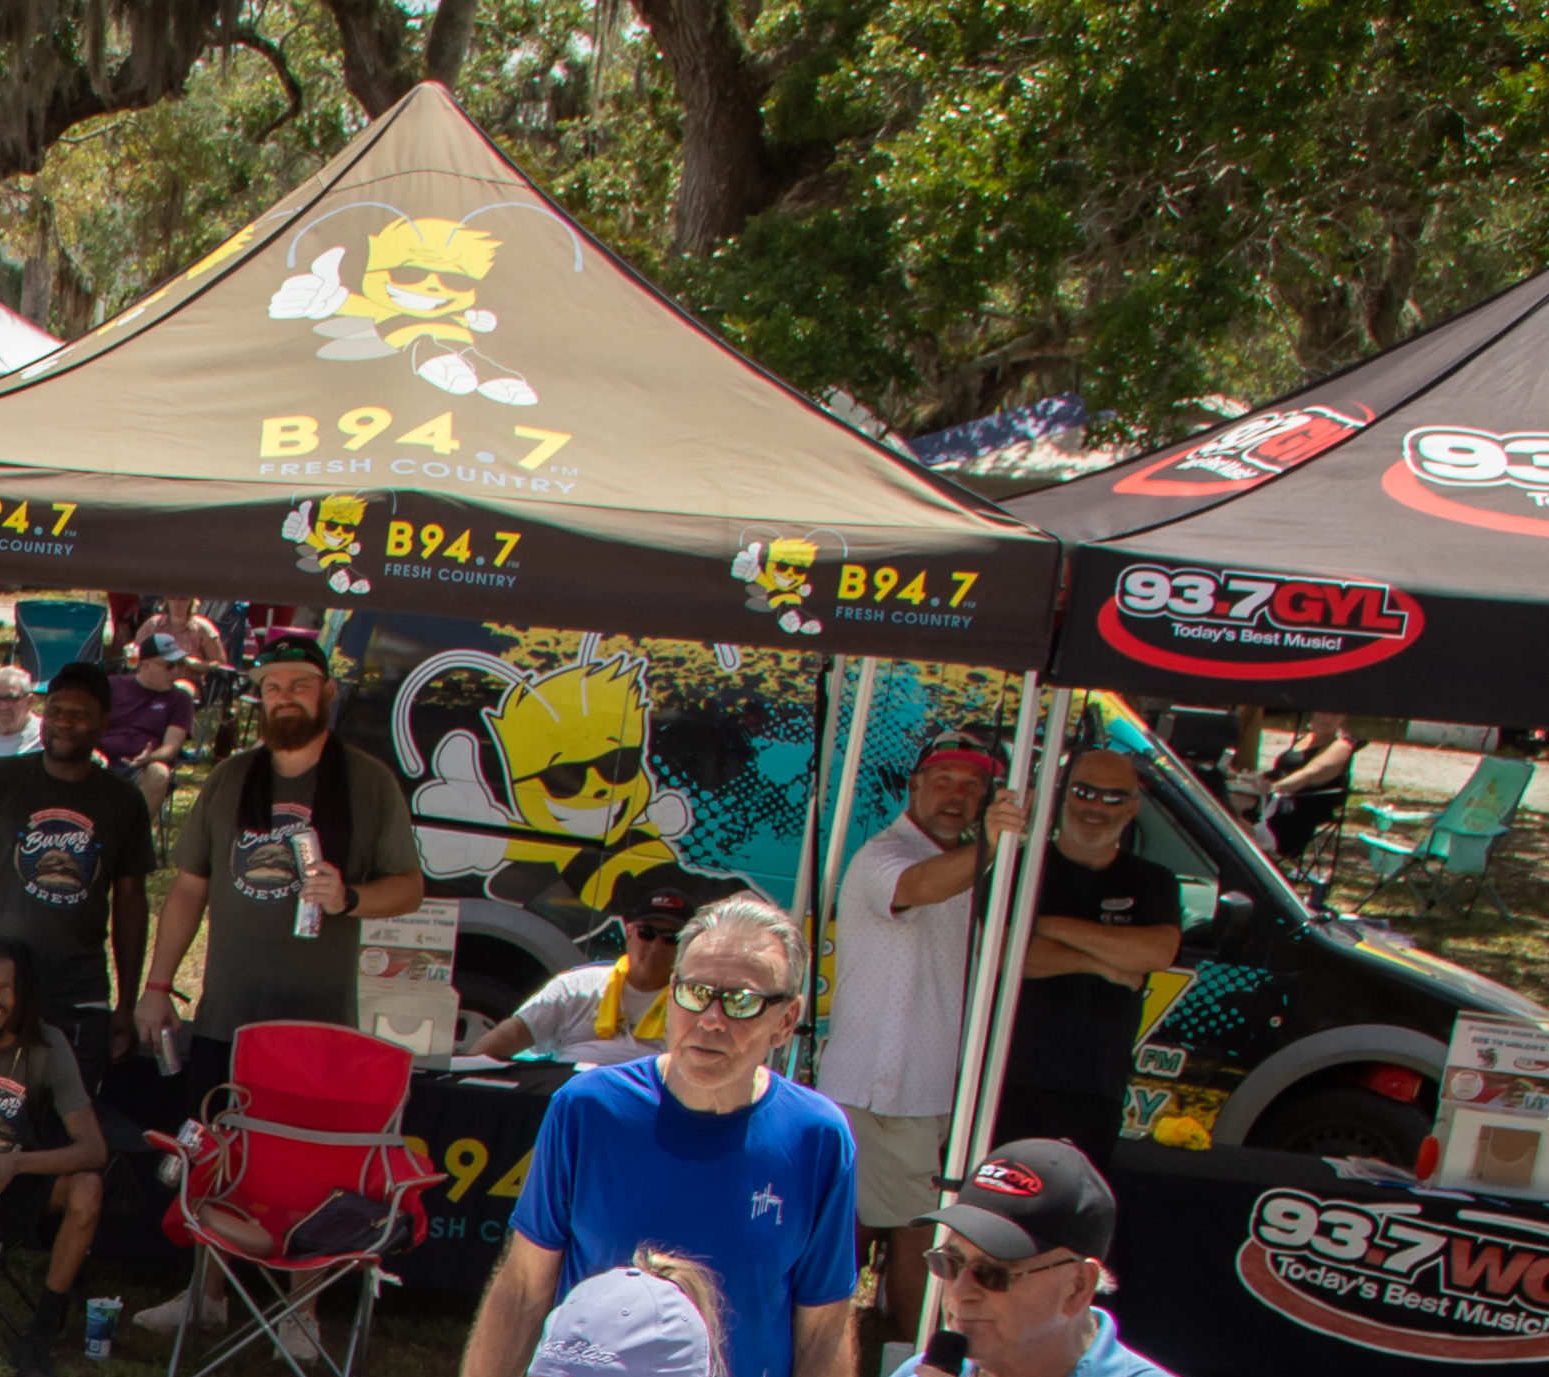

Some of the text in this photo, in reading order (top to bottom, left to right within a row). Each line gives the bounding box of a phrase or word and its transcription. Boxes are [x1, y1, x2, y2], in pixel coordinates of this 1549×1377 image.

[260, 406, 572, 471] B94.7
[259, 457, 577, 495] FRESH COUNTRY
[386, 521, 521, 568] B94.7
[384, 563, 517, 588] FRESH COUNTRY
[837, 563, 980, 609] B94.7
[835, 605, 973, 629] FRESH COUNTRY
[1171, 623, 1342, 651] Today's Best Music!
[20, 831, 90, 854] Burgers
[24, 881, 89, 905] BREWS
[232, 876, 303, 901] BREWS
[1141, 1048, 1184, 1073] FM
[1276, 1255, 1380, 1300] Today's
[1383, 1283, 1448, 1318] Best
